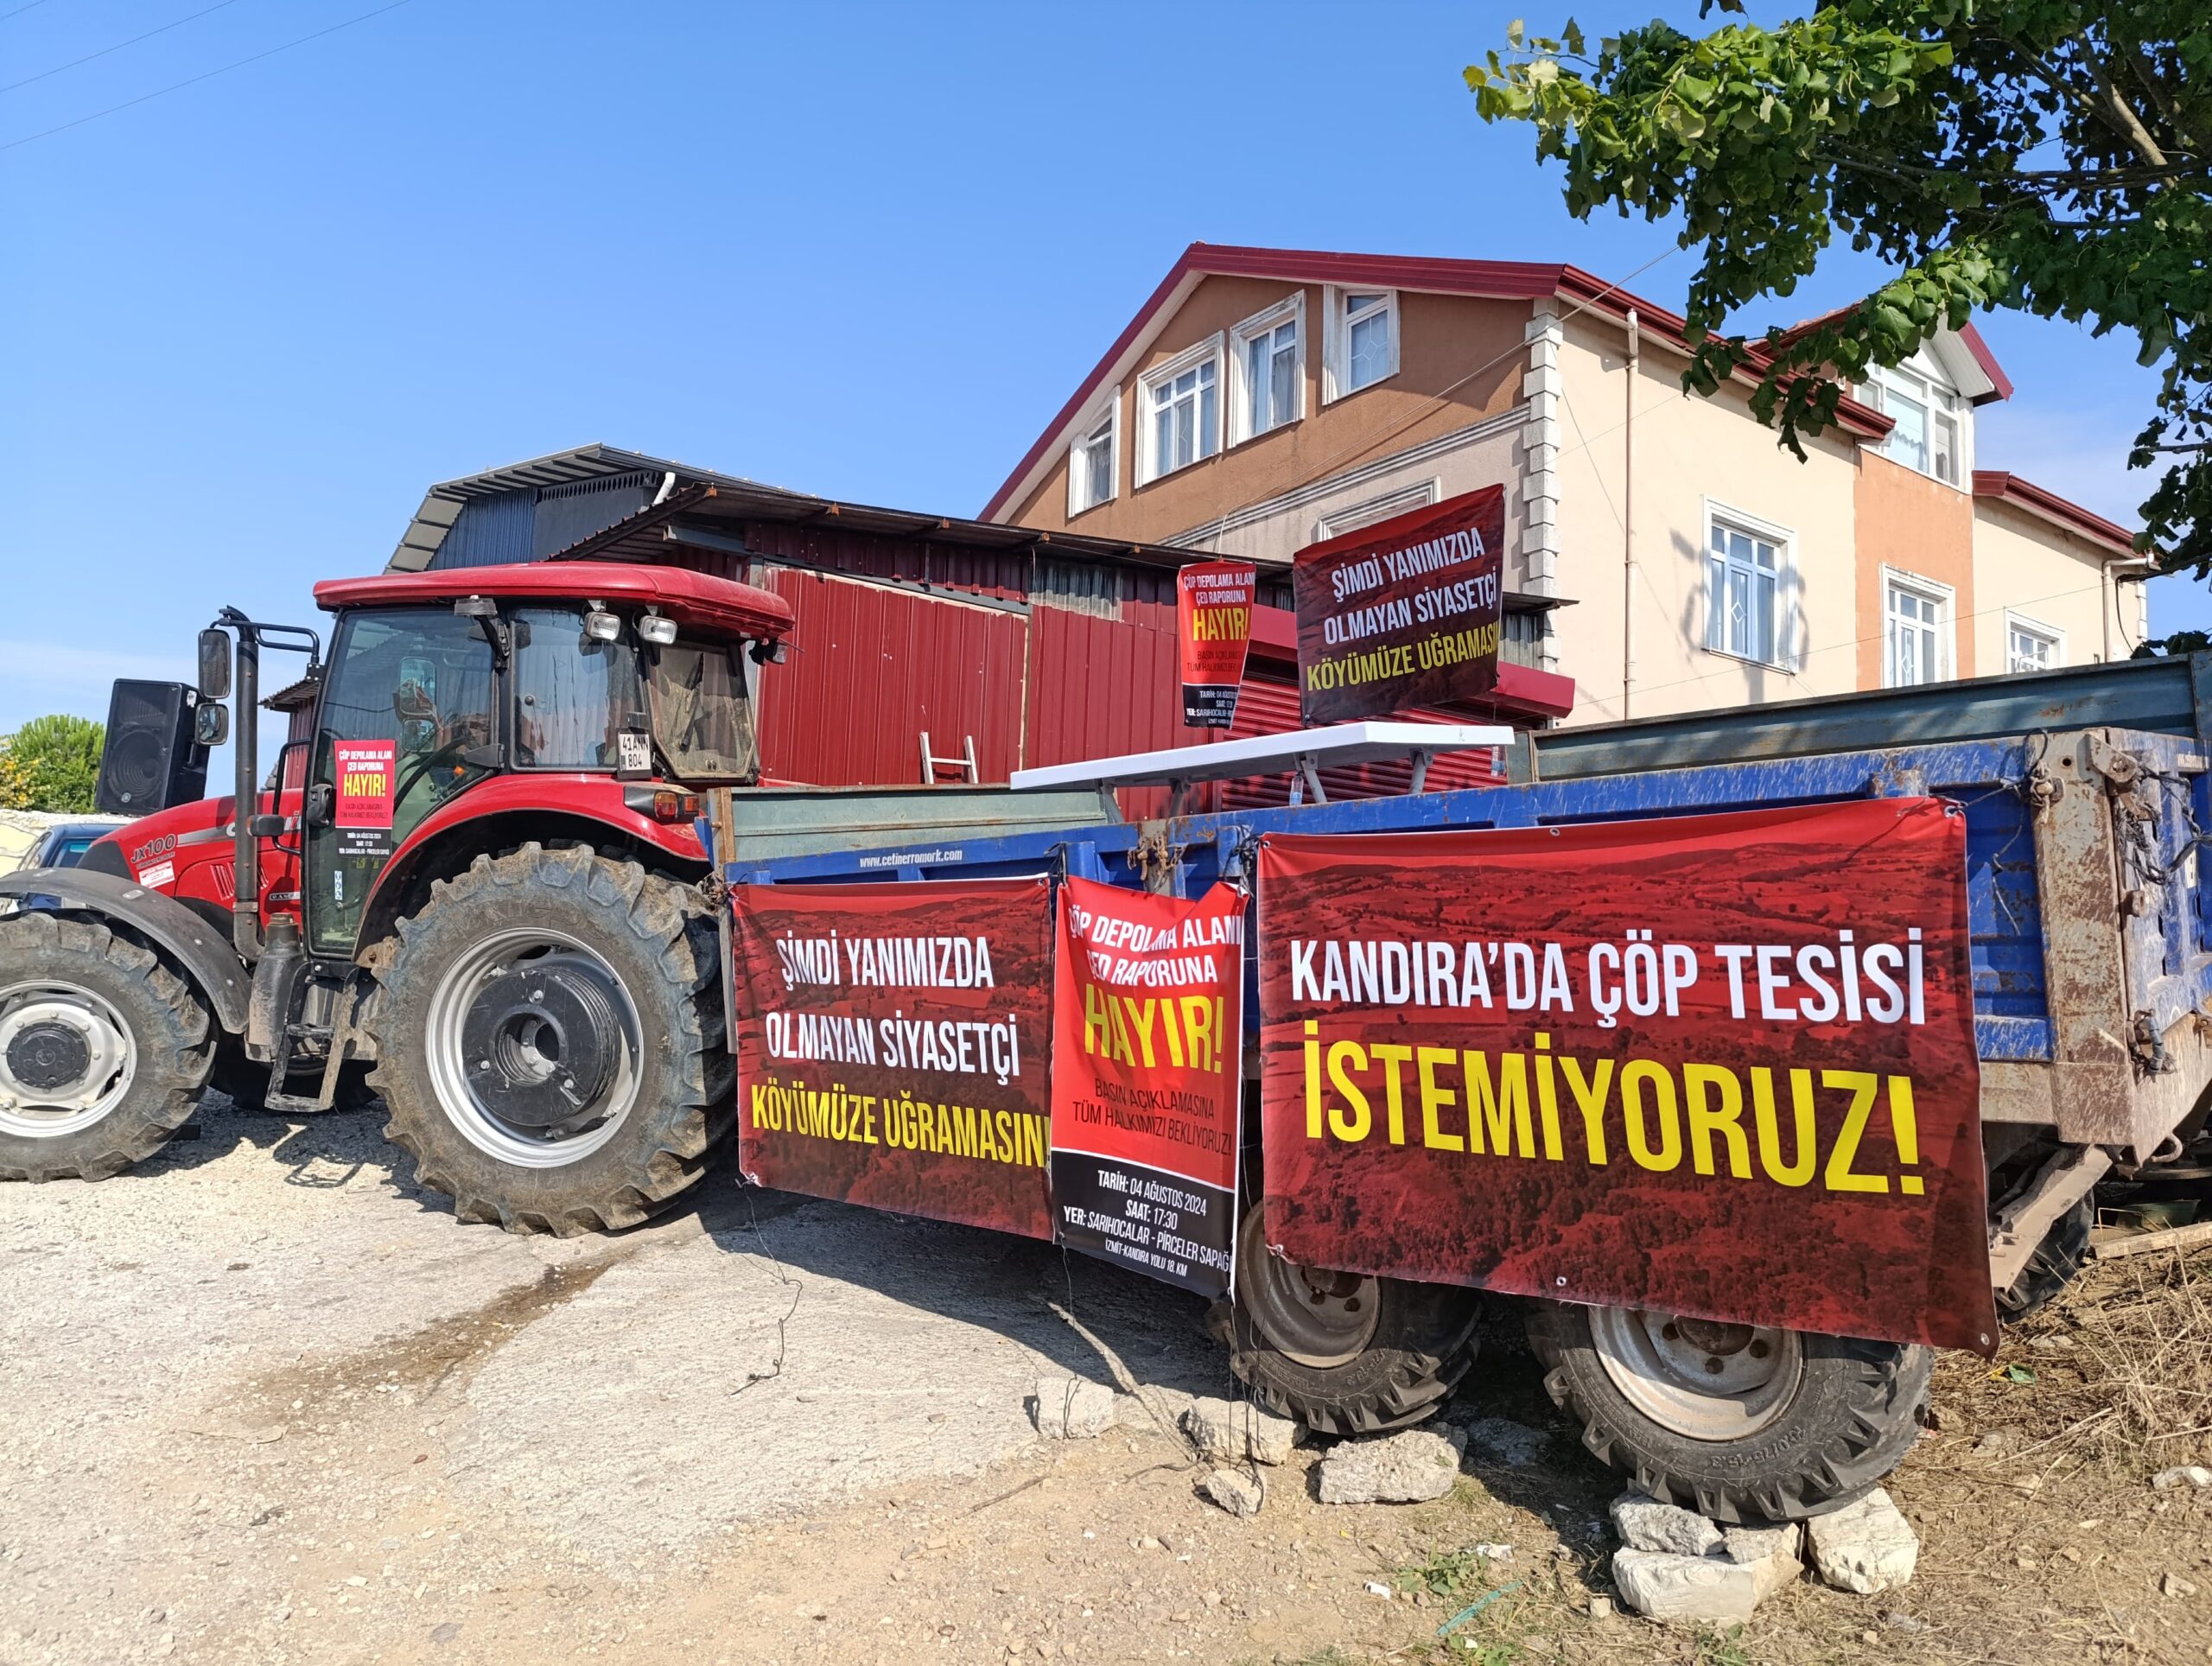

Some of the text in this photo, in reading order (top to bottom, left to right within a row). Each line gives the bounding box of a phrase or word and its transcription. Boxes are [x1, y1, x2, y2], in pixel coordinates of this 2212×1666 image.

[1197, 574, 1234, 588] DEPOLAMA
[1332, 527, 1485, 602] ŞİMDİ YANIMIZDA
[1196, 589, 1246, 607] ÇED RAPORUNA
[1324, 566, 1497, 645] OLMAYAN SİYASETÇİ
[1193, 607, 1249, 641] HAYIR!
[1306, 645, 1415, 691] KÖYÜMÜZE
[628, 754, 642, 767] 804
[343, 773, 386, 797] HAYIR!
[130, 833, 176, 863] JX100
[860, 849, 963, 868] www.cetinerromork.com
[1183, 915, 1241, 949] ALANI
[776, 929, 994, 991] ŞİMDİ YANIMIZDA
[1110, 955, 1218, 987] RAPORUNA
[1290, 927, 1925, 1028] KANDIRA’DA ÇÖP TESİSİ
[766, 1010, 1020, 1085] OLMAYAN SİYASETÇİ
[1084, 983, 1224, 1074] HAYIR!
[751, 1078, 879, 1145] KÖYÜMÜZE
[1095, 1078, 1214, 1121] BASIN AÇIKLAMASINA
[1304, 1020, 1925, 1196] İSTEMİYORUZ!
[1072, 1099, 1232, 1156] TÜM HALKIMIZI BEKLİYORUZ!
[1097, 1170, 1207, 1216] TARİH: 04 AĞUSTOS 2024
[1125, 1199, 1178, 1230] SAAT: 17:30
[1064, 1205, 1086, 1225] YER:
[1087, 1211, 1150, 1245] SARIHOCALAR
[1157, 1230, 1198, 1262] PİRCELER
[1105, 1237, 1149, 1264] İZMİT-KANDIRA
[1150, 1253, 1166, 1270] YOLU
[1176, 1263, 1188, 1277] KM
